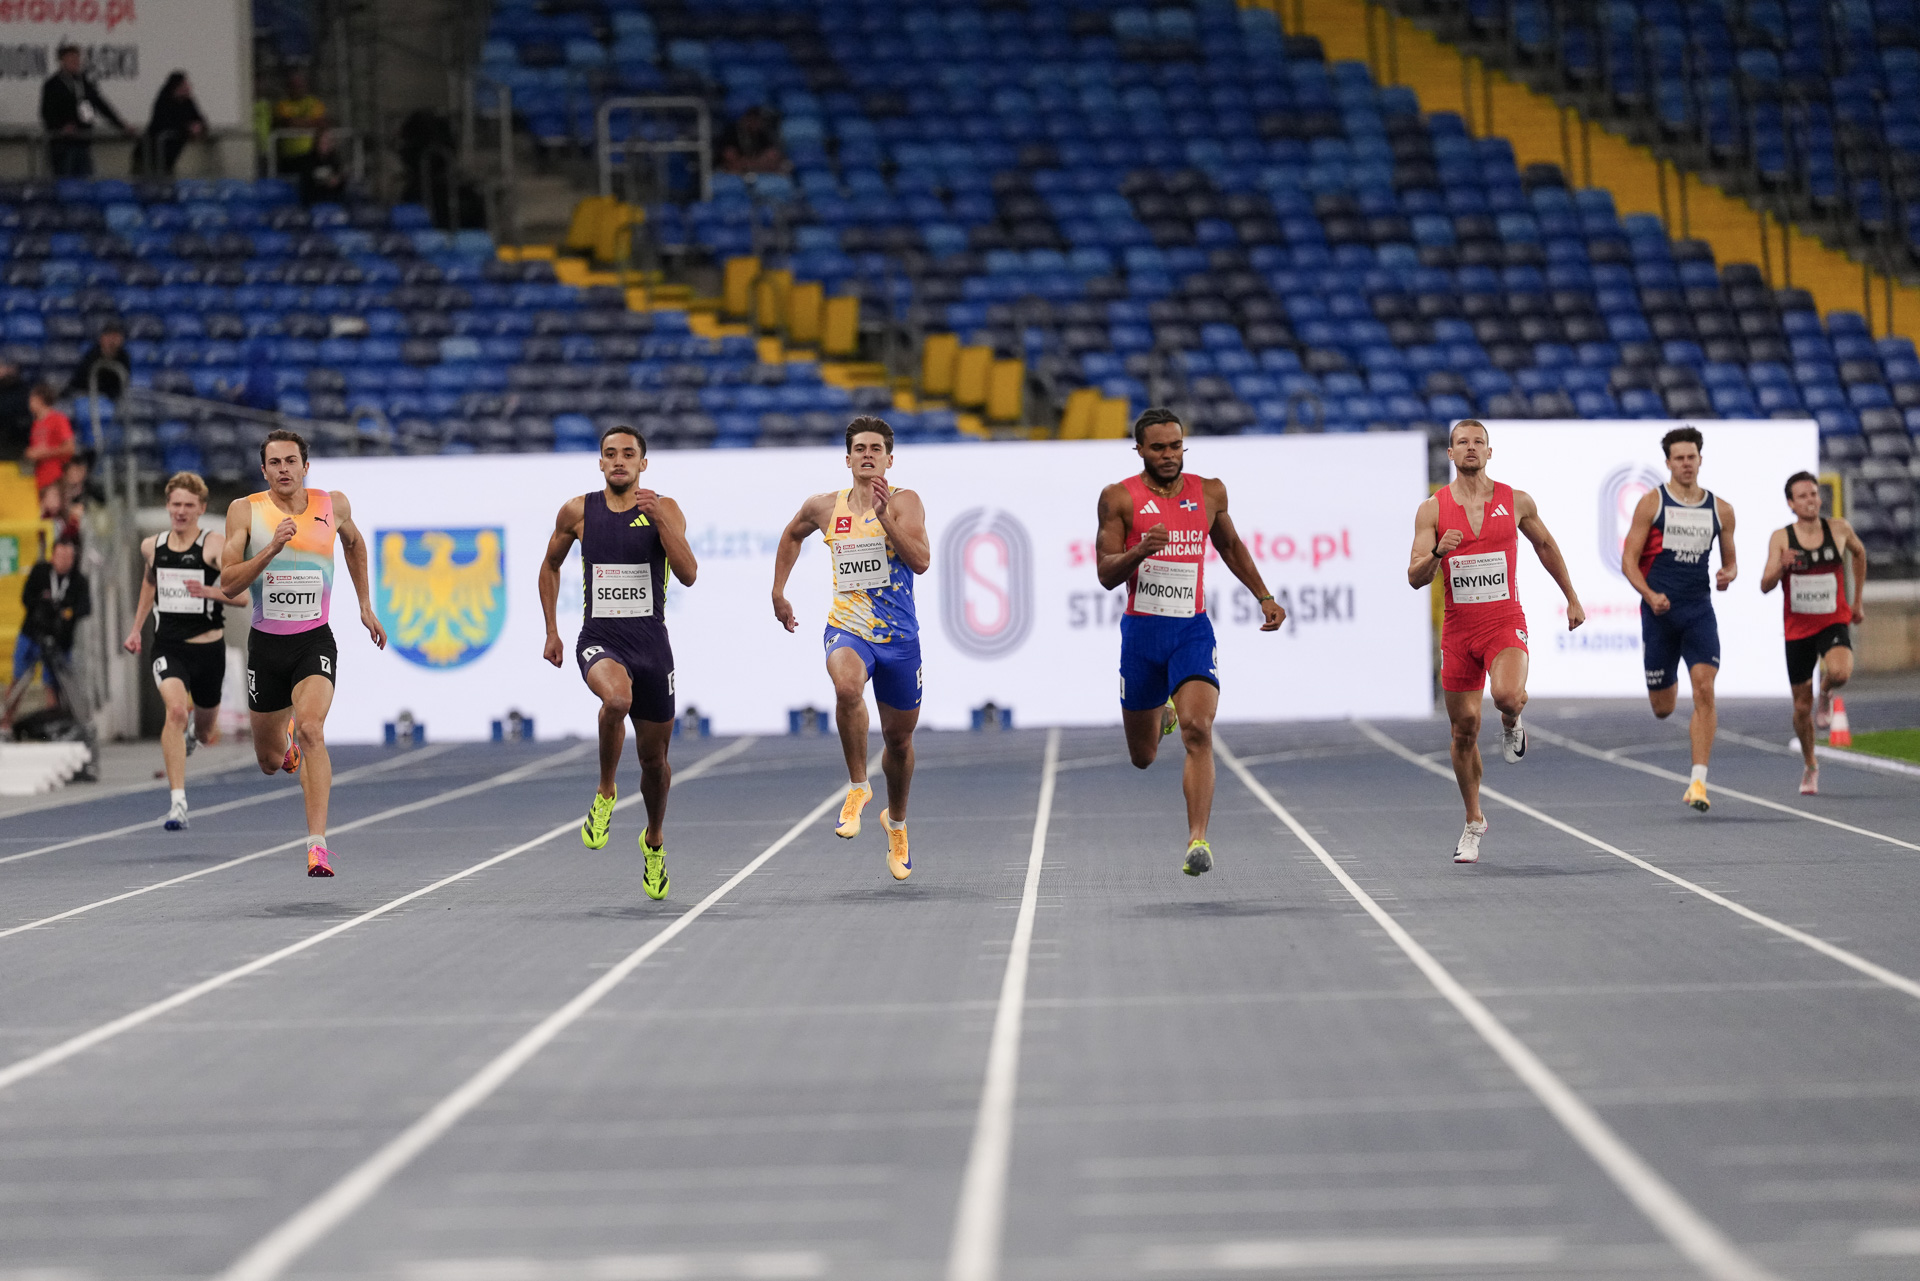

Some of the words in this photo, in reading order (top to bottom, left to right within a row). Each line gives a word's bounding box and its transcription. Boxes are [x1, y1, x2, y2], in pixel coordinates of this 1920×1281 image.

[839, 559, 882, 575] SZWED
[1453, 572, 1505, 588] ENYINGI
[159, 586, 190, 599] FRĄCKOW
[597, 586, 647, 600] SEGERS
[1138, 581, 1194, 600] MORONTA
[269, 592, 316, 605] SCOTTI
[321, 658, 330, 669] 7
